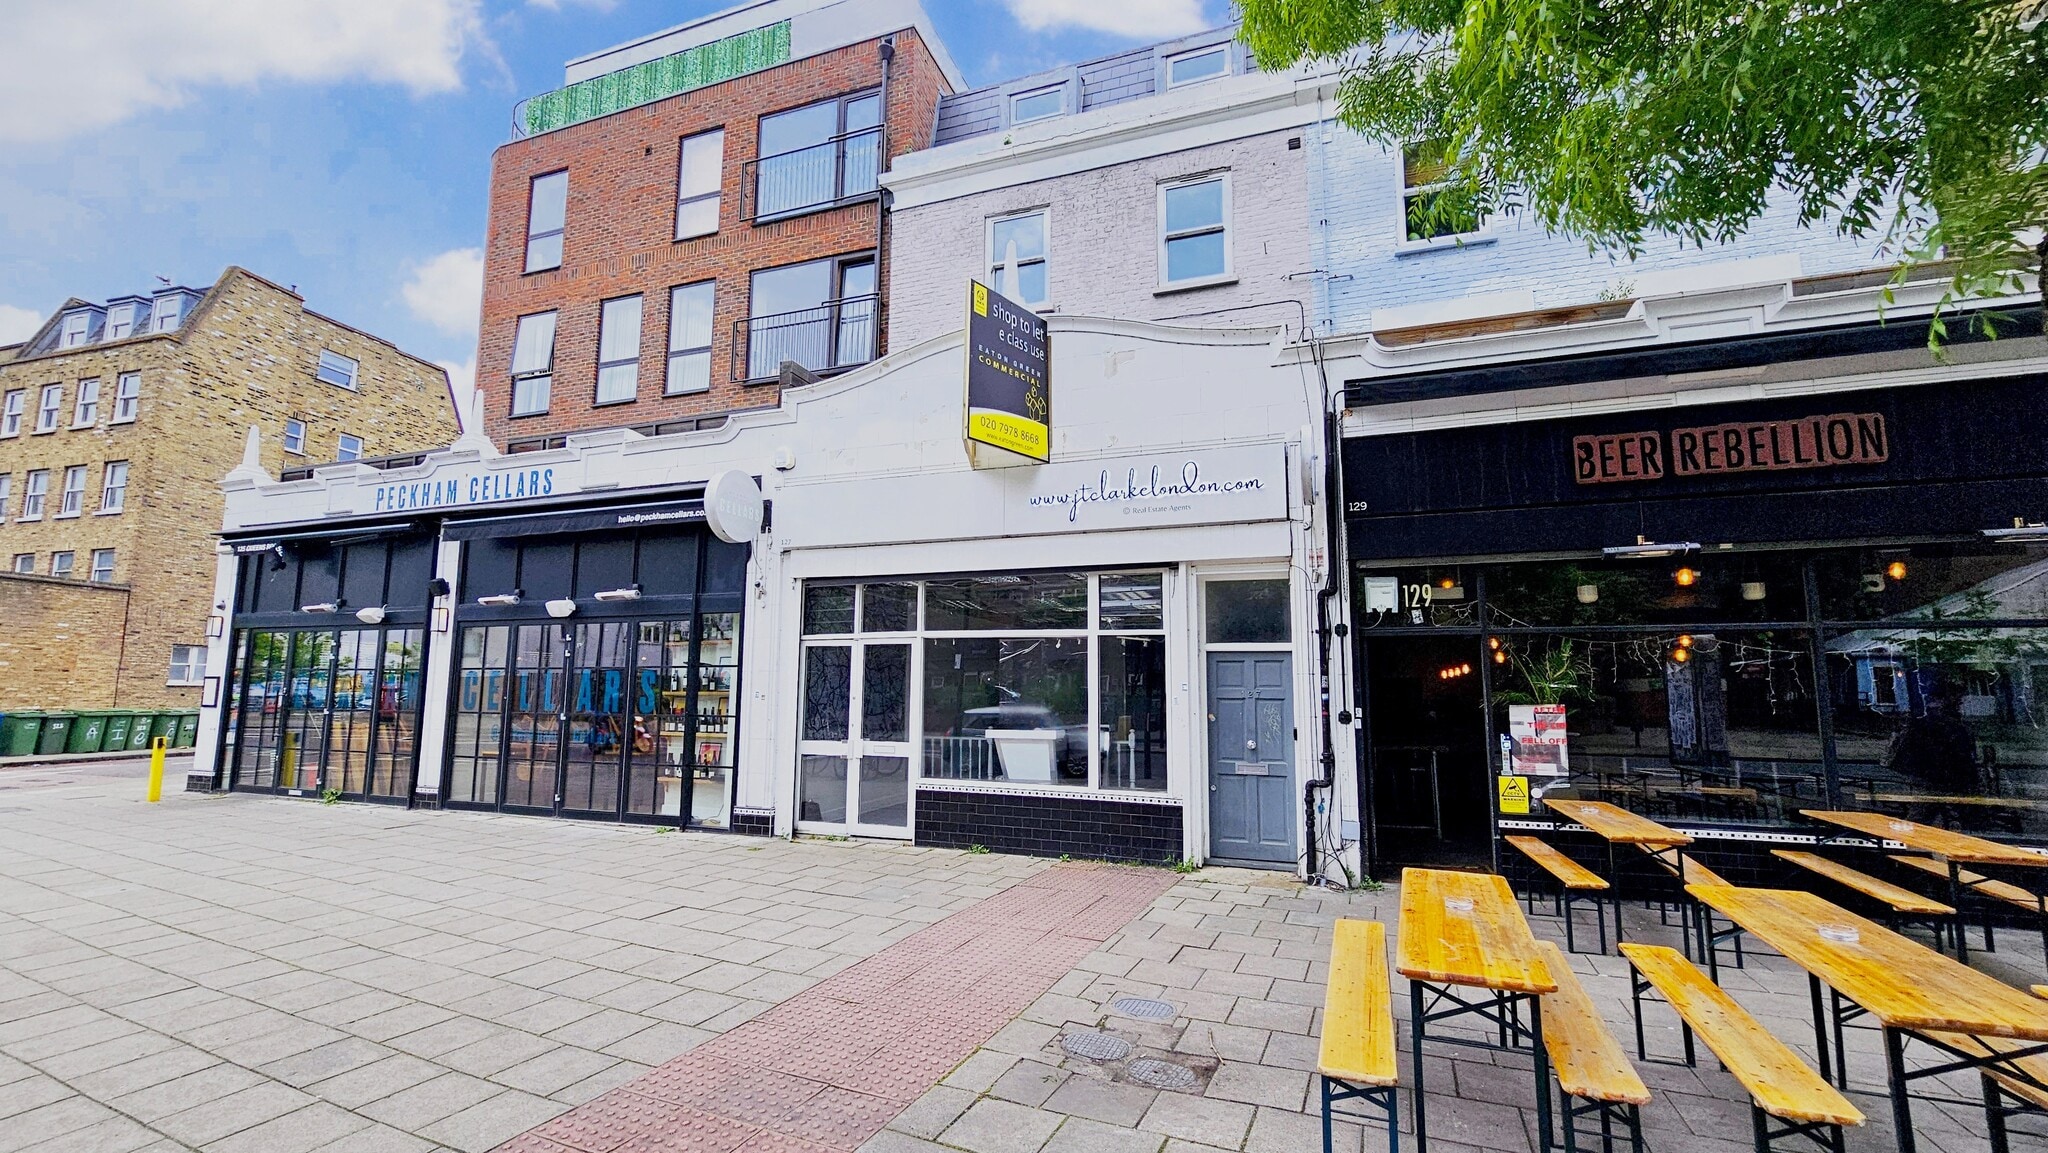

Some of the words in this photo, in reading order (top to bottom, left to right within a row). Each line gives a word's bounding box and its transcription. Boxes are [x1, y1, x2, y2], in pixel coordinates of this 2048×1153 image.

[993, 302, 1018, 329] shop
[1020, 316, 1031, 334] to
[1032, 321, 1045, 342] let
[978, 344, 1008, 363] EATON
[1013, 360, 1041, 378] GREEN
[999, 329, 1005, 341] e
[1007, 331, 1028, 353] class
[1030, 344, 1045, 361] use
[978, 355, 1041, 388] COMMERCIAL
[980, 416, 997, 430] 020
[1000, 422, 1019, 438] 7978
[1020, 430, 1040, 445] 8668
[1577, 437, 1663, 480] BEER
[1679, 416, 1886, 471] REBELLION
[375, 479, 458, 511] PECKHAM
[469, 468, 553, 502] CELLARS
[1132, 507, 1147, 515] Real
[1147, 504, 1168, 513] Estate
[1169, 503, 1192, 512] Agents
[1348, 501, 1368, 512] 129
[1402, 584, 1432, 608] 129
[462, 668, 659, 715] CELLARS
